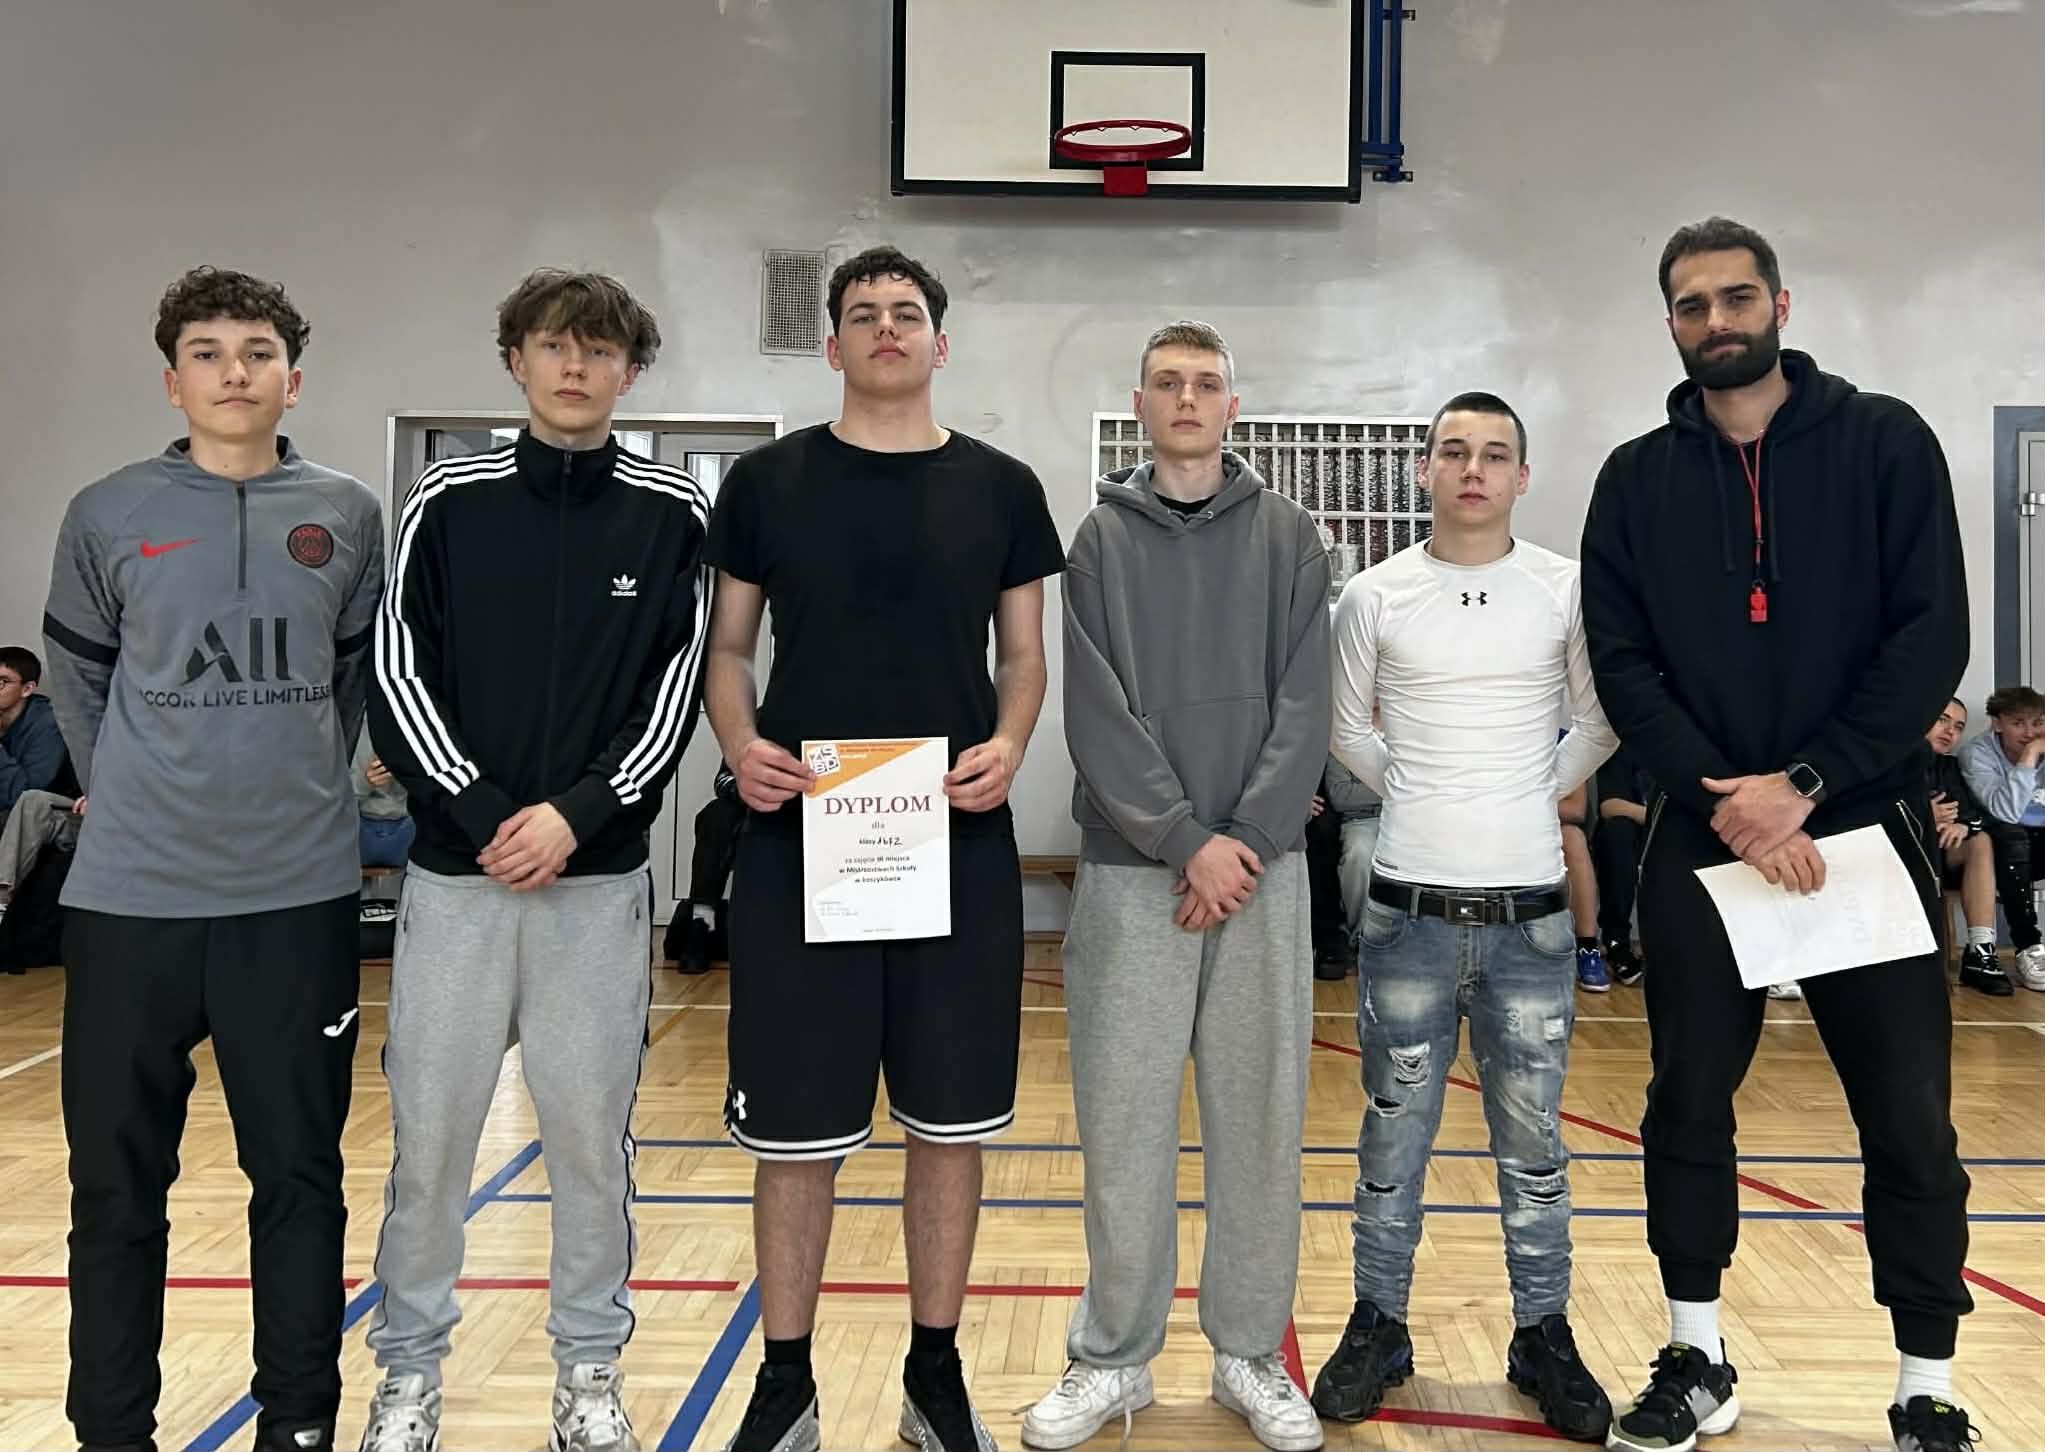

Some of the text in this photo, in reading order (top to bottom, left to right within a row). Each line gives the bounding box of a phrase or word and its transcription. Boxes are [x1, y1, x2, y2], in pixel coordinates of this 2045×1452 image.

[203, 690, 248, 708] LIVE
[824, 795, 933, 815] DYPLOM
[871, 820, 885, 829] dla
